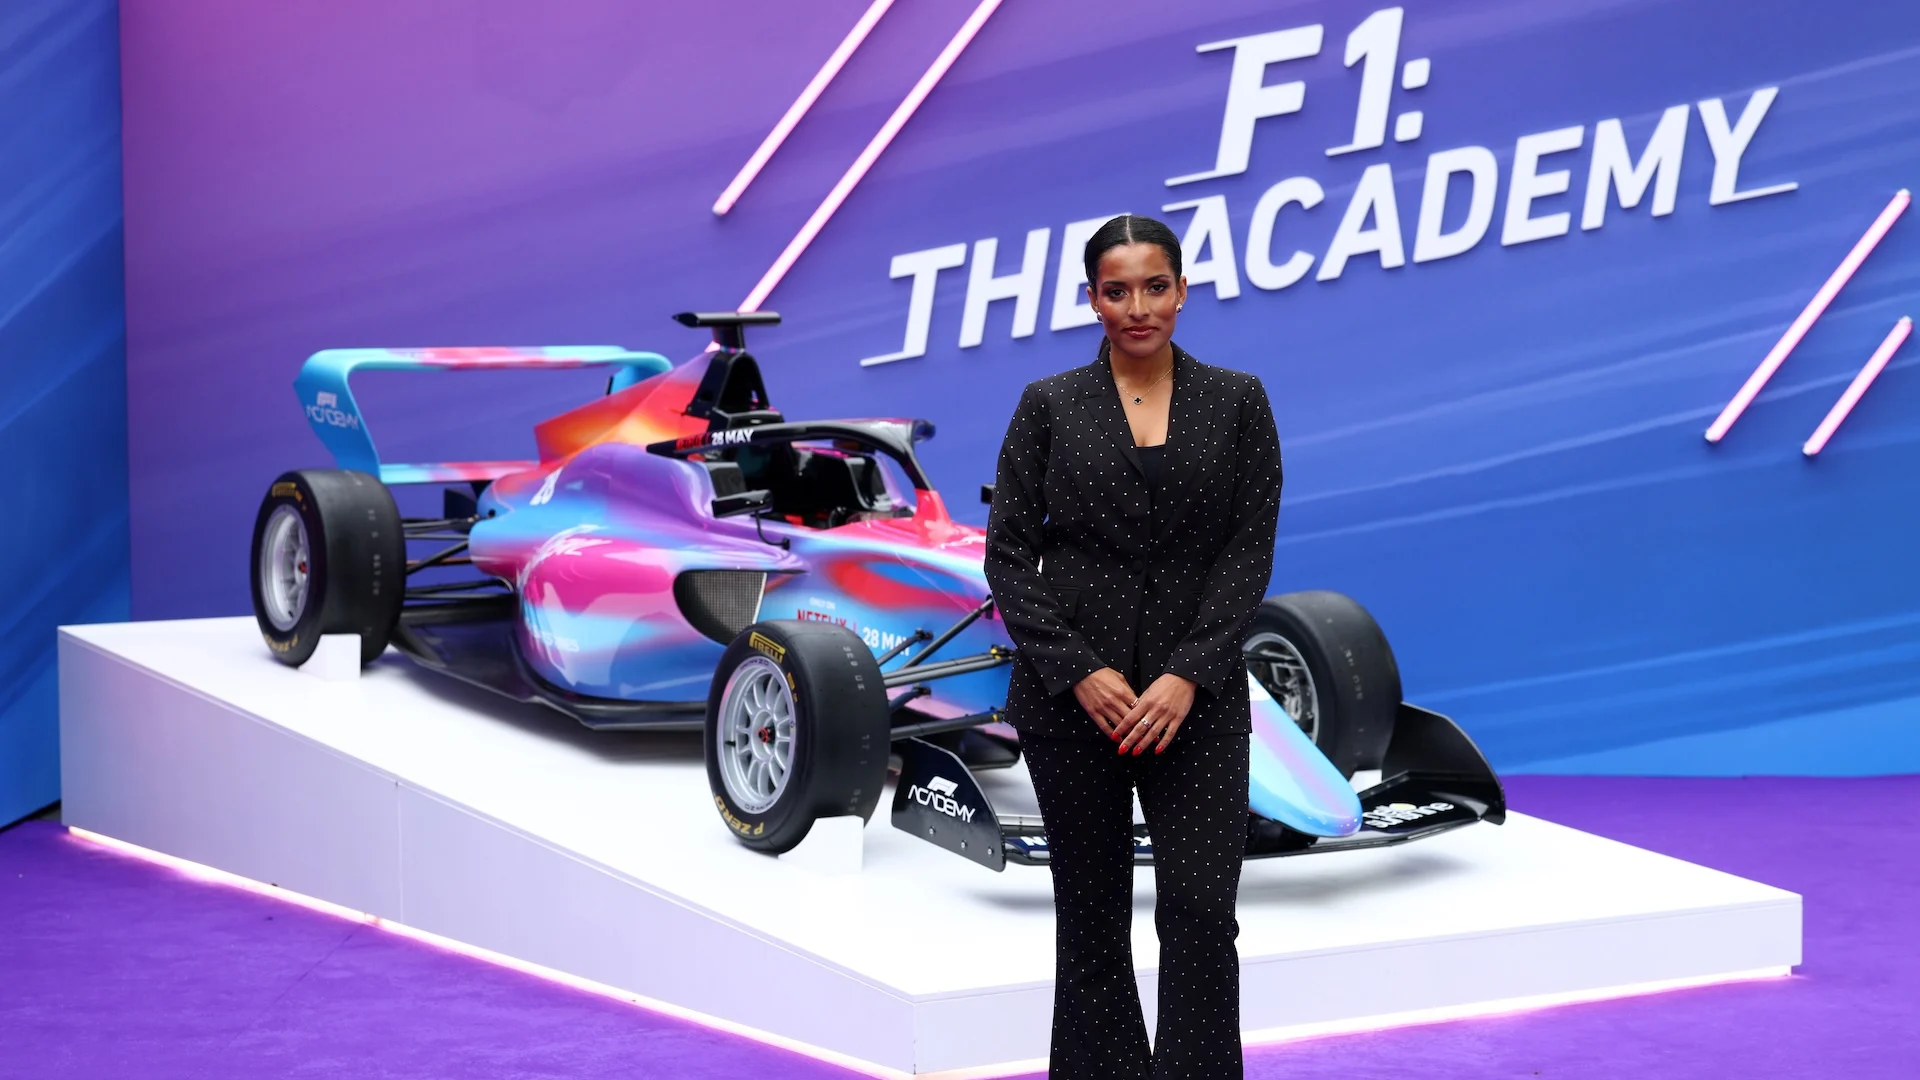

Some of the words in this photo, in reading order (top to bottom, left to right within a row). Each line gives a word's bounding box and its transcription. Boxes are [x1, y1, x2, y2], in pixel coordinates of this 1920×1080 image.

[1162, 87, 1798, 300] ACADEMY
[725, 428, 754, 444] MAY
[749, 631, 786, 664] PIRELLI
[862, 626, 879, 648] 28
[714, 794, 752, 835] ZERO
[907, 784, 976, 823] ACADEMY
